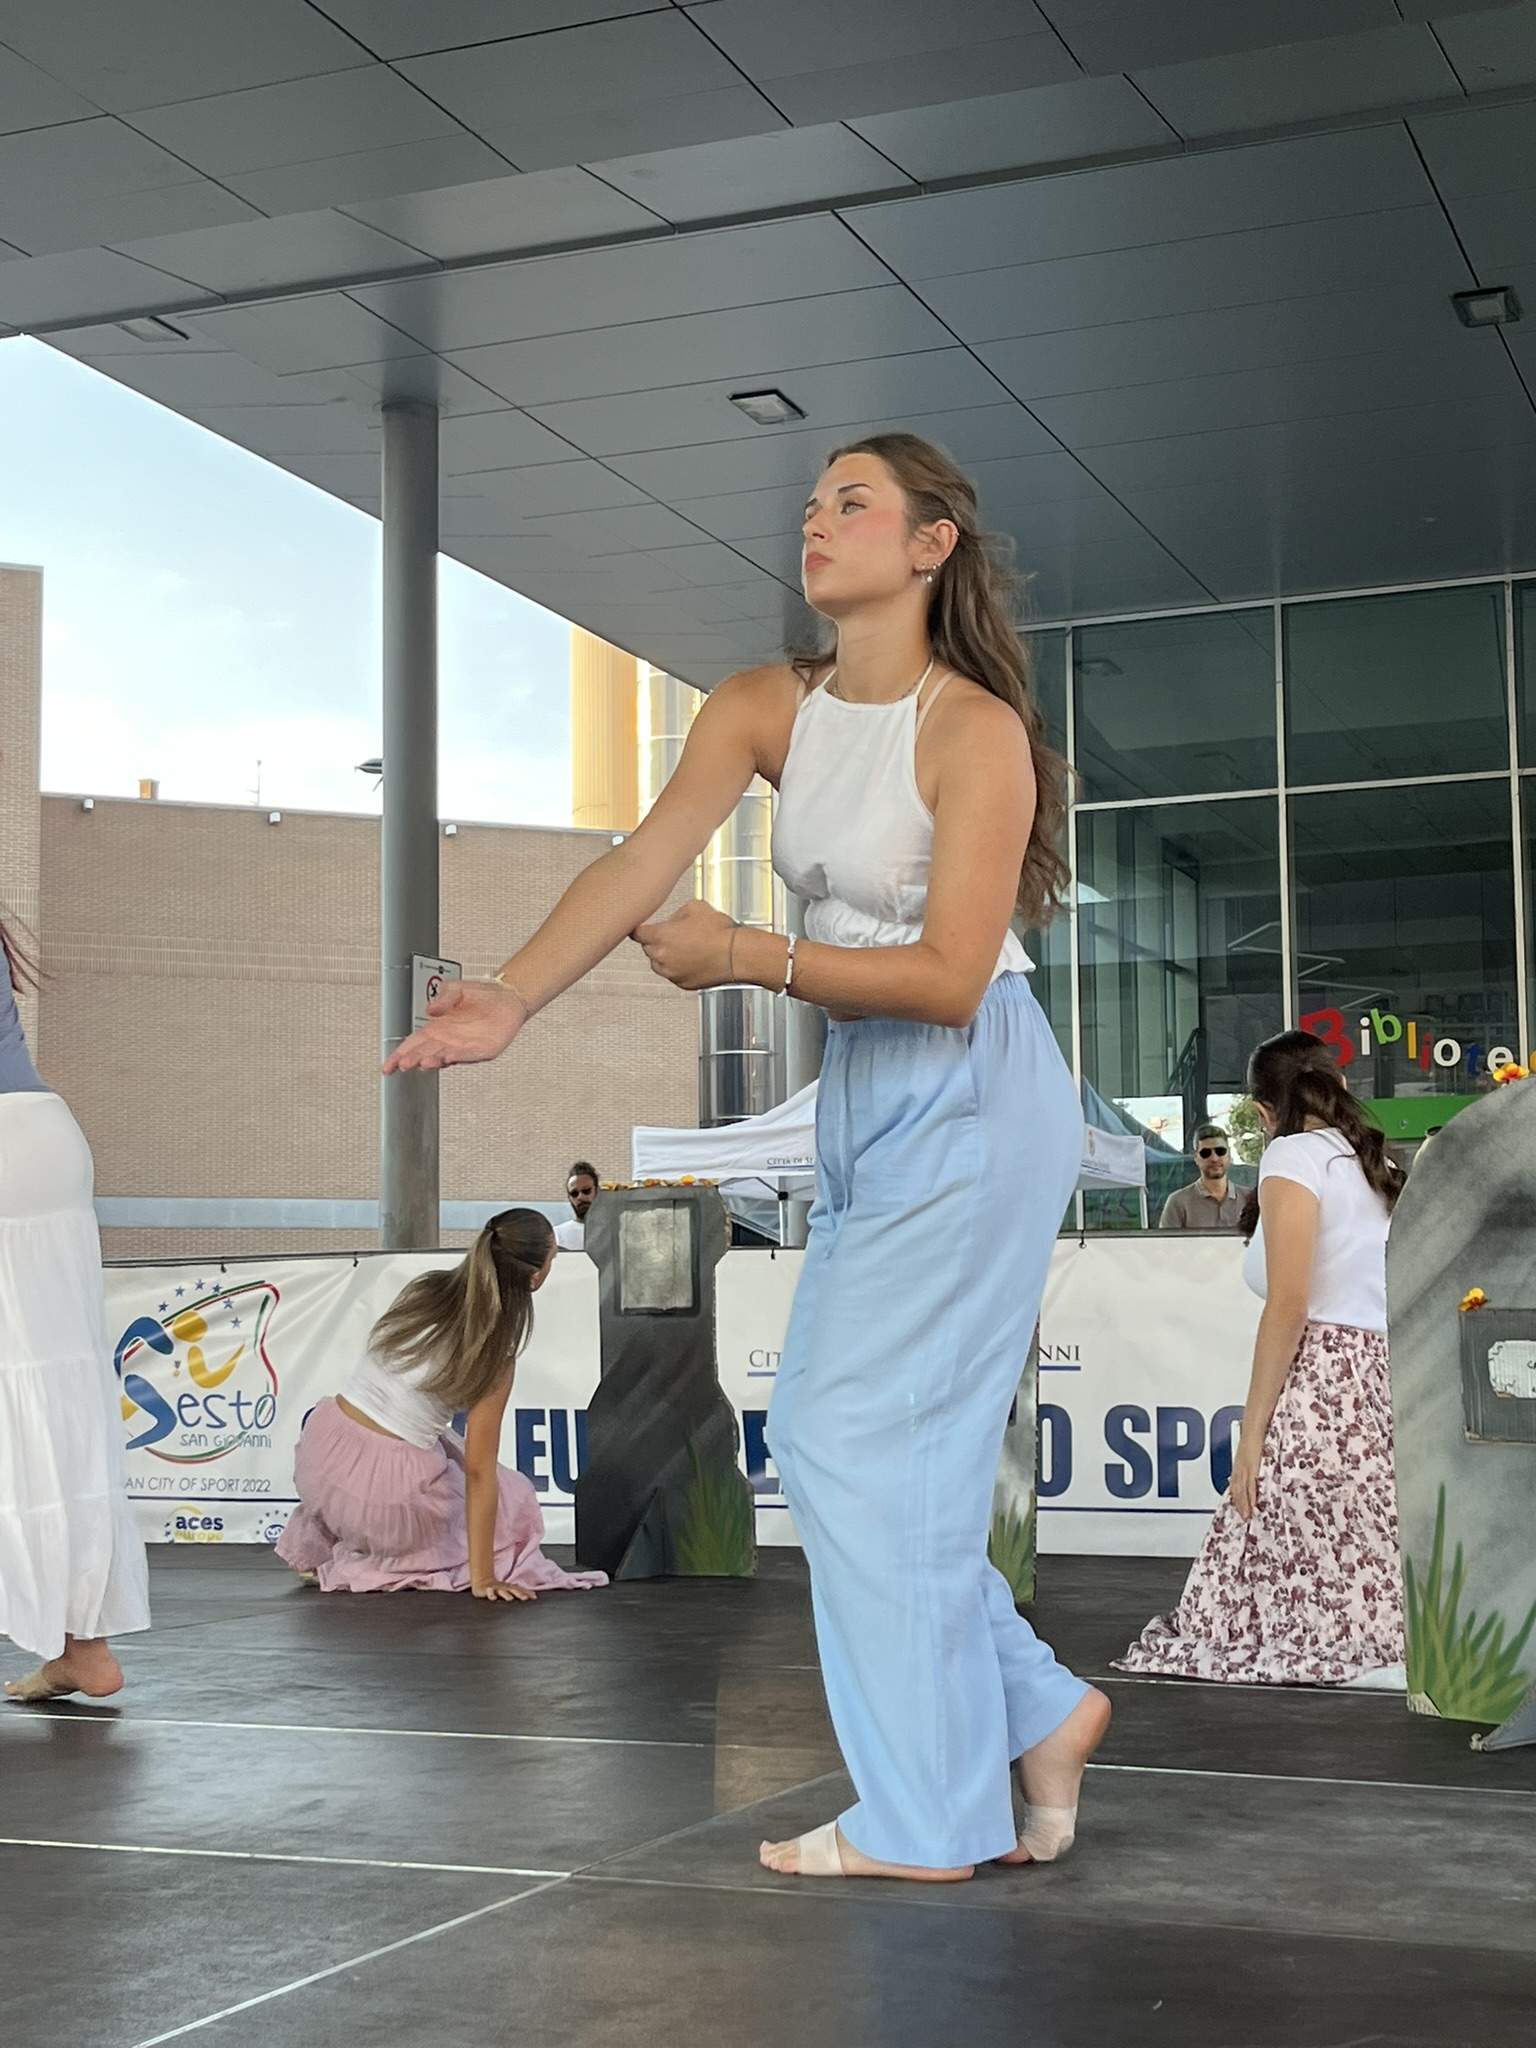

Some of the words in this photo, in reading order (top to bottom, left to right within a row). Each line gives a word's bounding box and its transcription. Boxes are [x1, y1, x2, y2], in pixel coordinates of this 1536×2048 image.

[1299, 1008, 1536, 1077] Bibliote
[749, 1349, 781, 1368] CIT
[1039, 1344, 1081, 1361] NNI
[1104, 1404, 1246, 1499] SPO
[125, 1477, 145, 1490] AN
[148, 1477, 175, 1491] CITY
[179, 1477, 198, 1491] OF
[200, 1477, 240, 1492] SPORT
[242, 1478, 271, 1493] 2022
[176, 1515, 224, 1531] aces
